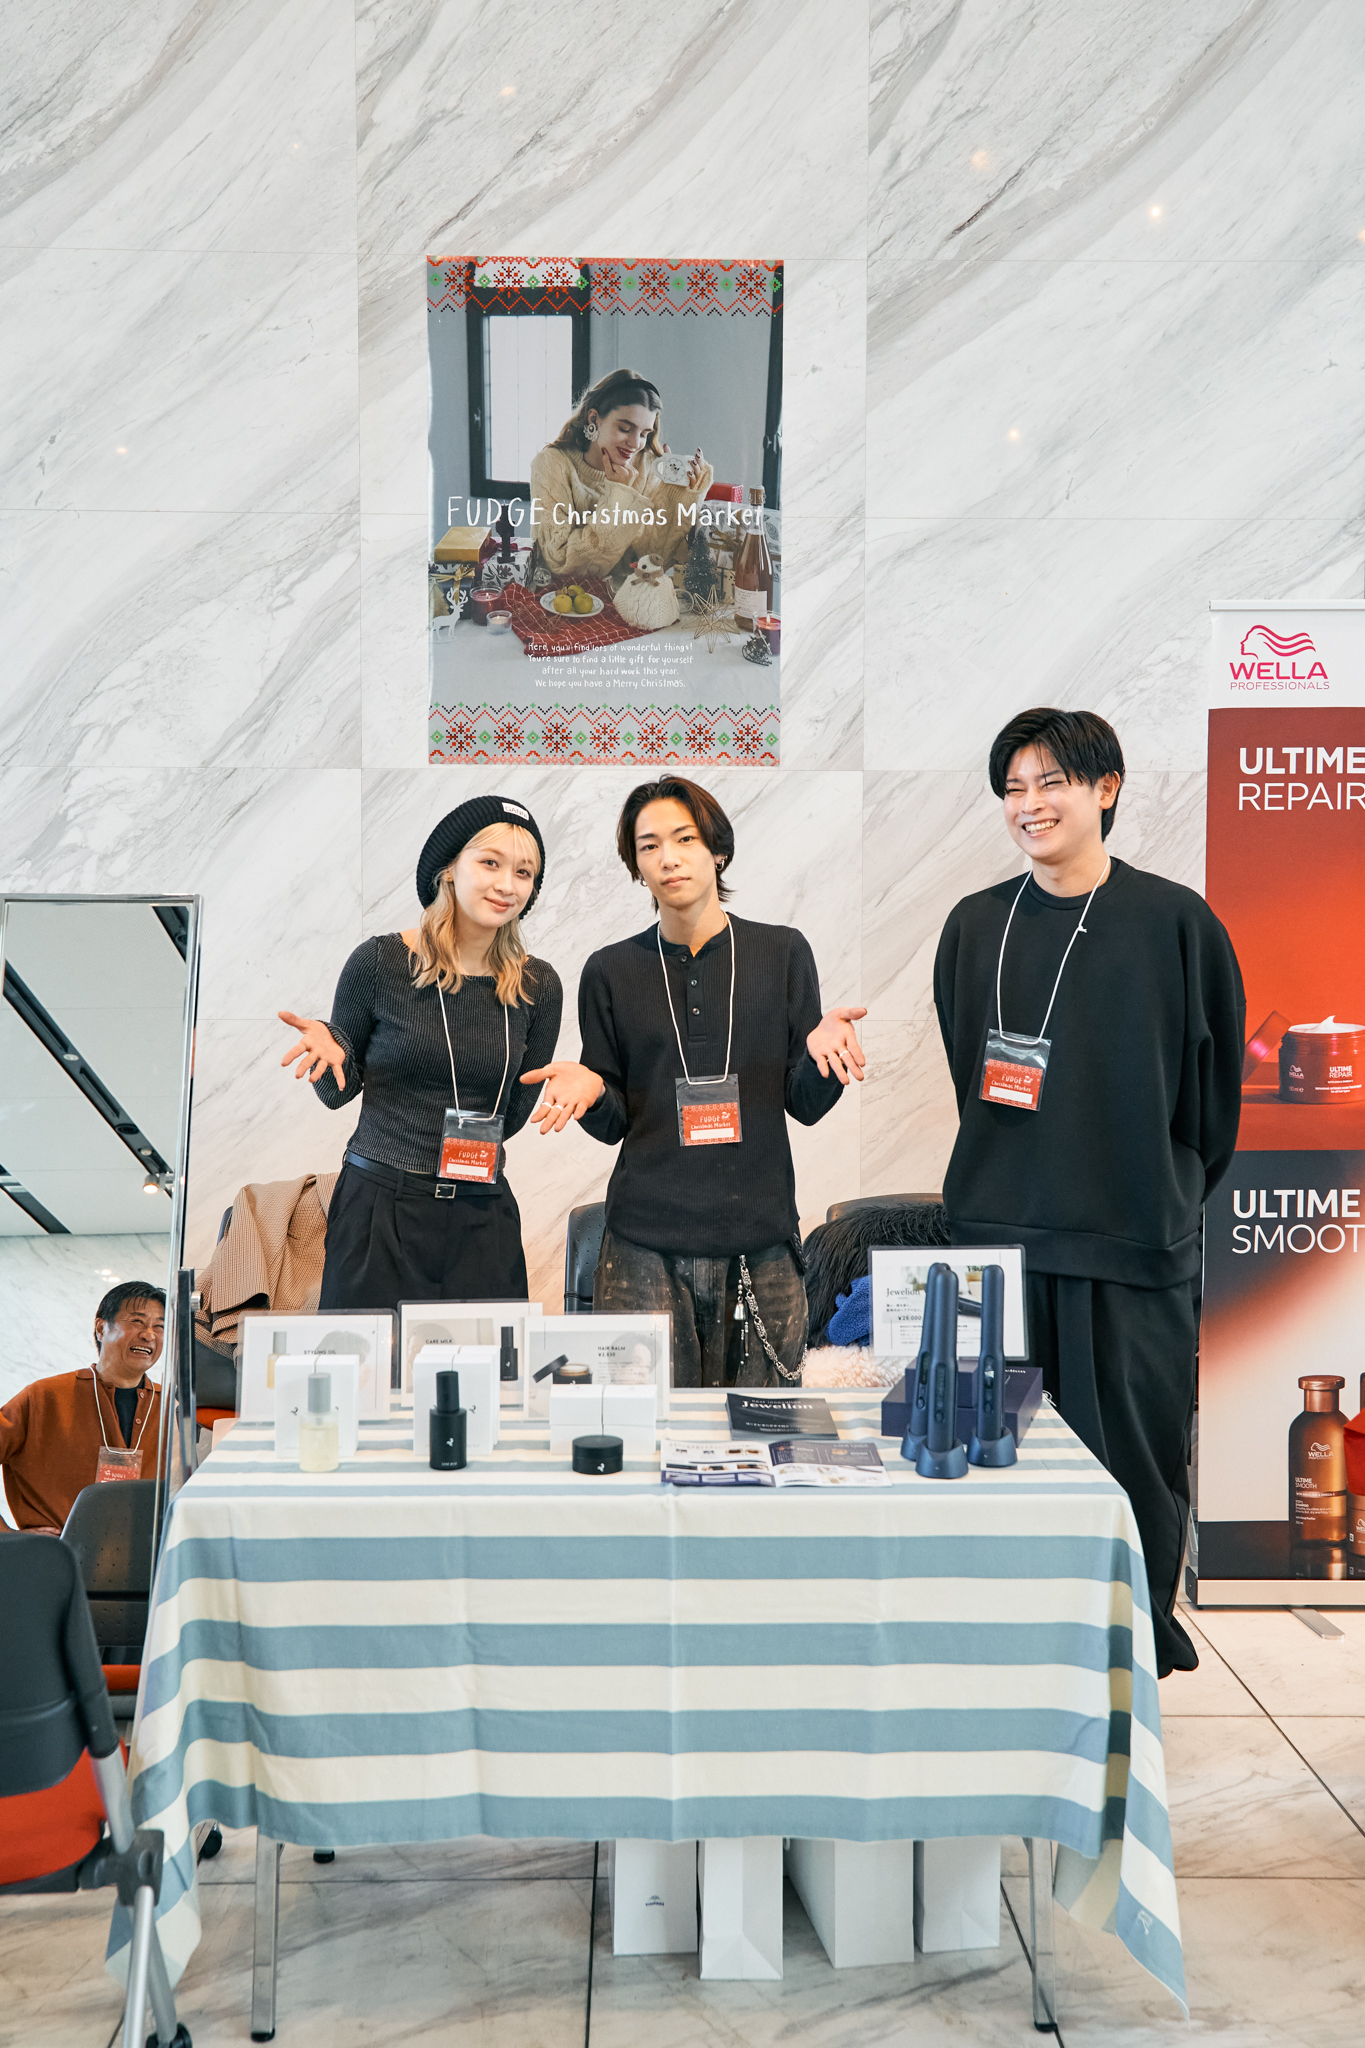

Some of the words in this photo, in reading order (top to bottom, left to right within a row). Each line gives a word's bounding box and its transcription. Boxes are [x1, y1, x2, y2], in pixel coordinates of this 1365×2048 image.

[447, 496, 544, 527] FUDGE
[552, 502, 667, 526] Christmas
[677, 502, 763, 527] Market
[528, 642, 549, 652] Here,
[551, 643, 571, 653] you'll
[574, 641, 590, 651] find
[592, 644, 607, 652] lots
[609, 643, 618, 652] of
[620, 642, 661, 652] wonderful
[663, 642, 693, 653] things!
[527, 653, 551, 663] You're
[553, 655, 570, 663] sure
[572, 655, 580, 663] to
[582, 655, 598, 663] find
[608, 654, 627, 664] little
[628, 653, 644, 665] gift
[648, 654, 660, 664] for
[661, 655, 694, 666] yourself
[541, 665, 564, 675] after
[566, 666, 577, 674] all
[579, 668, 597, 678] your
[599, 666, 619, 675] hard
[620, 666, 641, 675] work
[643, 666, 658, 675] this
[660, 668, 680, 677] year.
[1229, 661, 1329, 680] WELLA
[535, 679, 547, 687] We
[548, 678, 567, 689] hope
[568, 681, 582, 689] you
[584, 679, 603, 688] have
[612, 678, 638, 690] Merry
[640, 678, 686, 688] Christmas.
[1230, 681, 1330, 690] PROFESSIONALS
[1239, 746, 1365, 775] ULTIME
[1238, 781, 1365, 811] REPAIR
[1001, 1073, 1023, 1084] FUDGE
[458, 1150, 479, 1159] FUDGE
[1232, 1188, 1361, 1219] ULTIME
[886, 1287, 921, 1297] Jewelion
[741, 1400, 814, 1410] Jewelion
